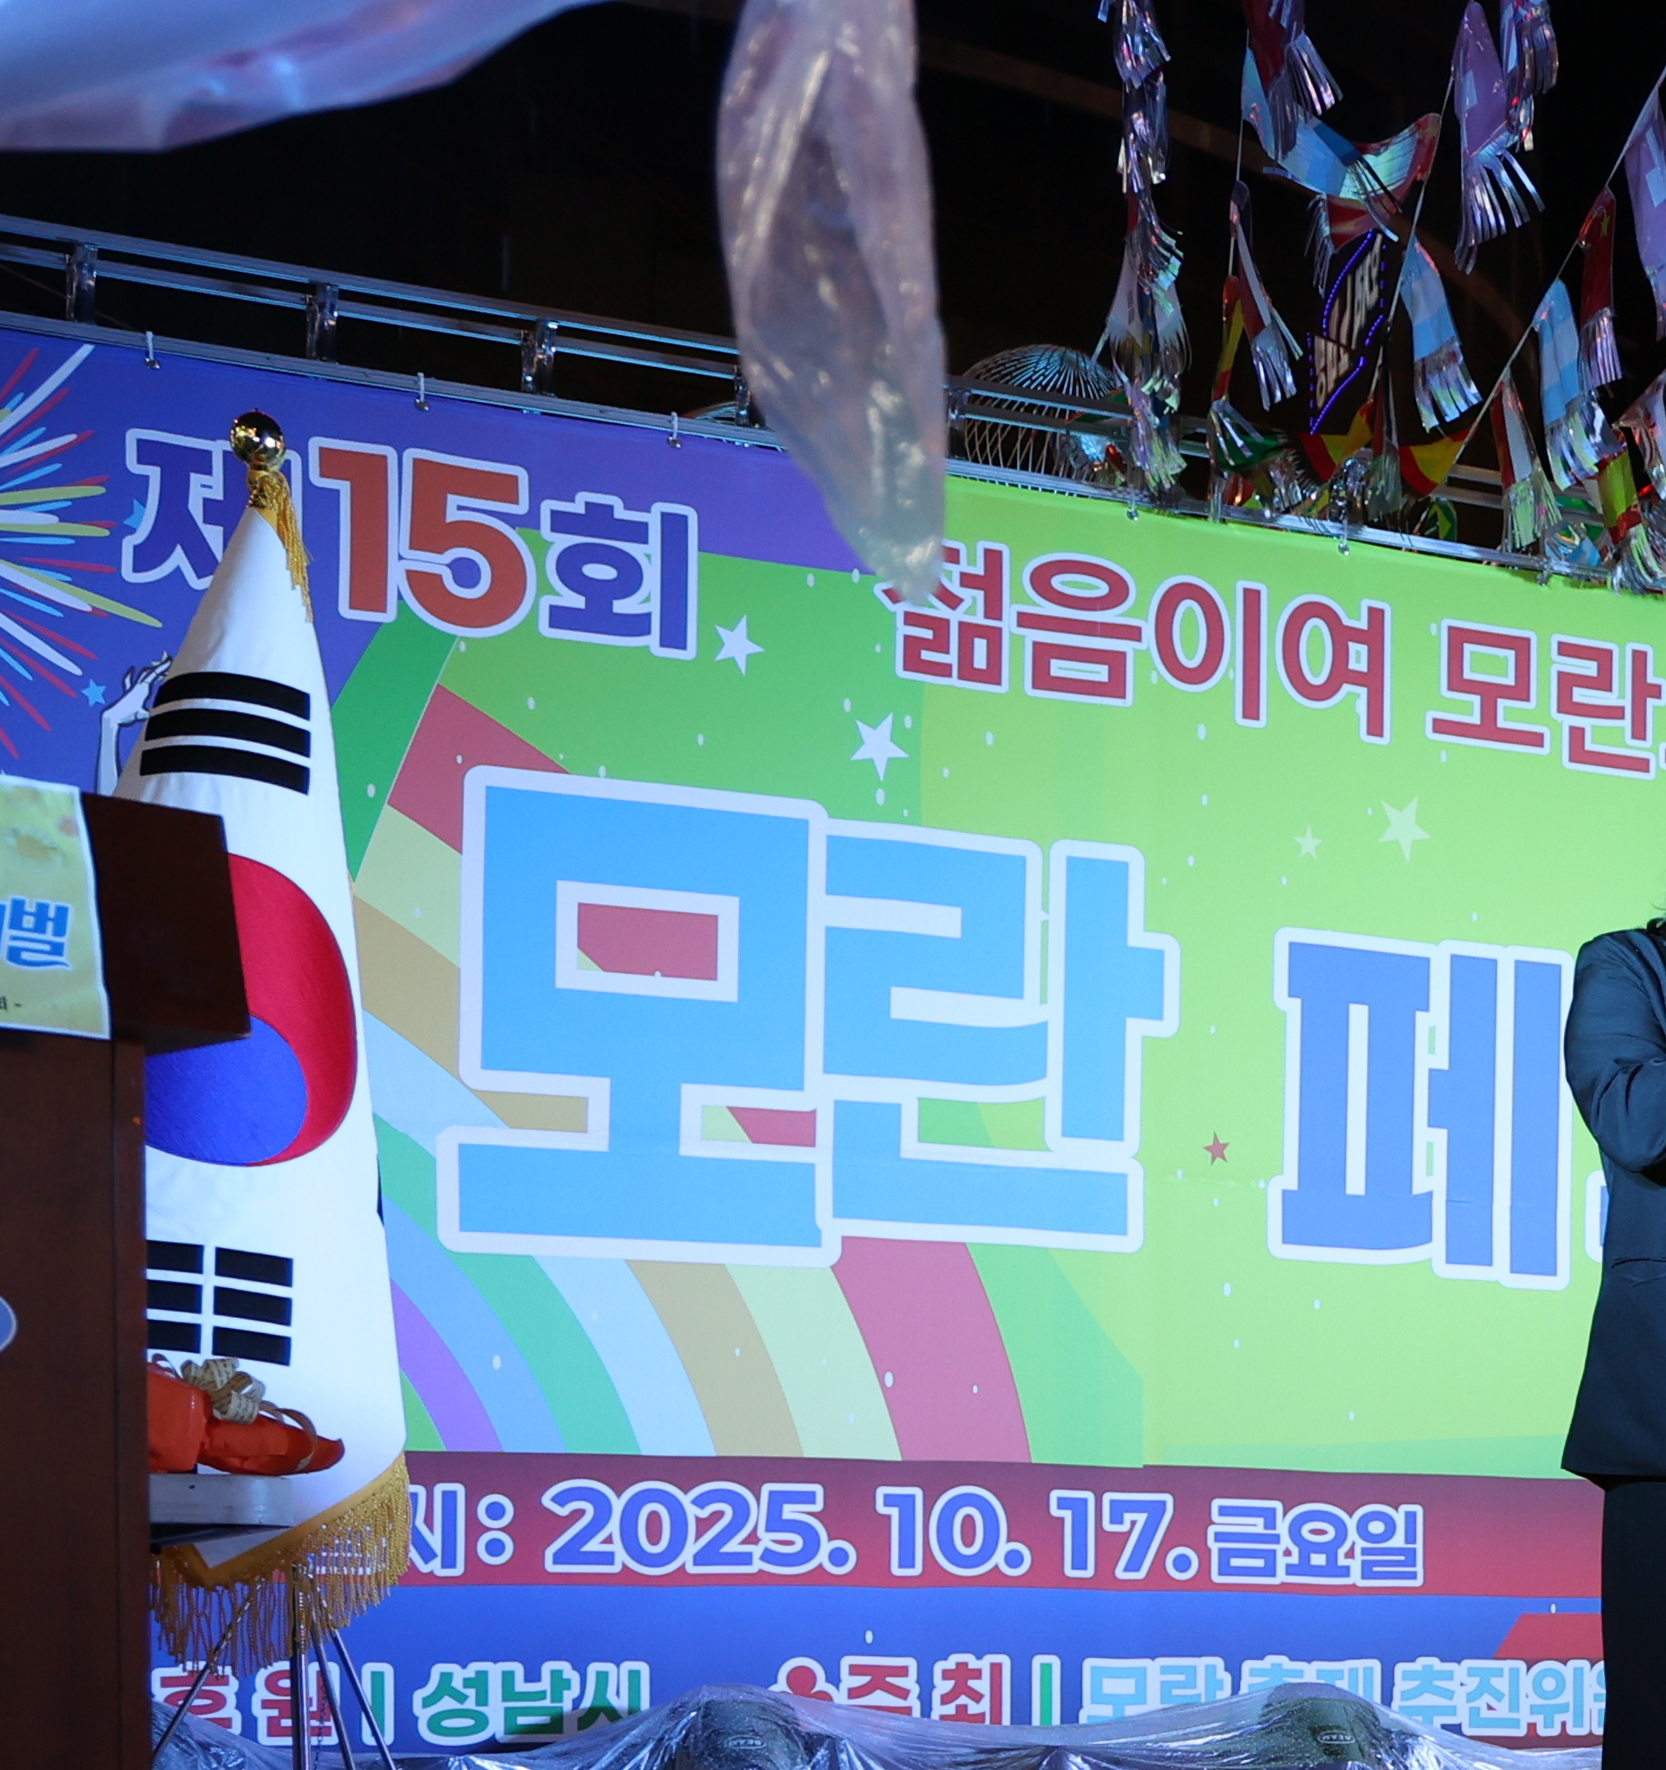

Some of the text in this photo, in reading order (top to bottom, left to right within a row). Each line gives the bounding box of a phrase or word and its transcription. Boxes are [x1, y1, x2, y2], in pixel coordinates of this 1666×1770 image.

[121, 427, 698, 662] 제15회
[875, 541, 1393, 745] 젊음이여
[435, 763, 1180, 1268] 모란
[541, 1479, 857, 1576] 2025.
[877, 1483, 1031, 1578] 10.
[412, 1660, 652, 1746] 성남시
[1395, 1656, 1605, 1739] 추진위
